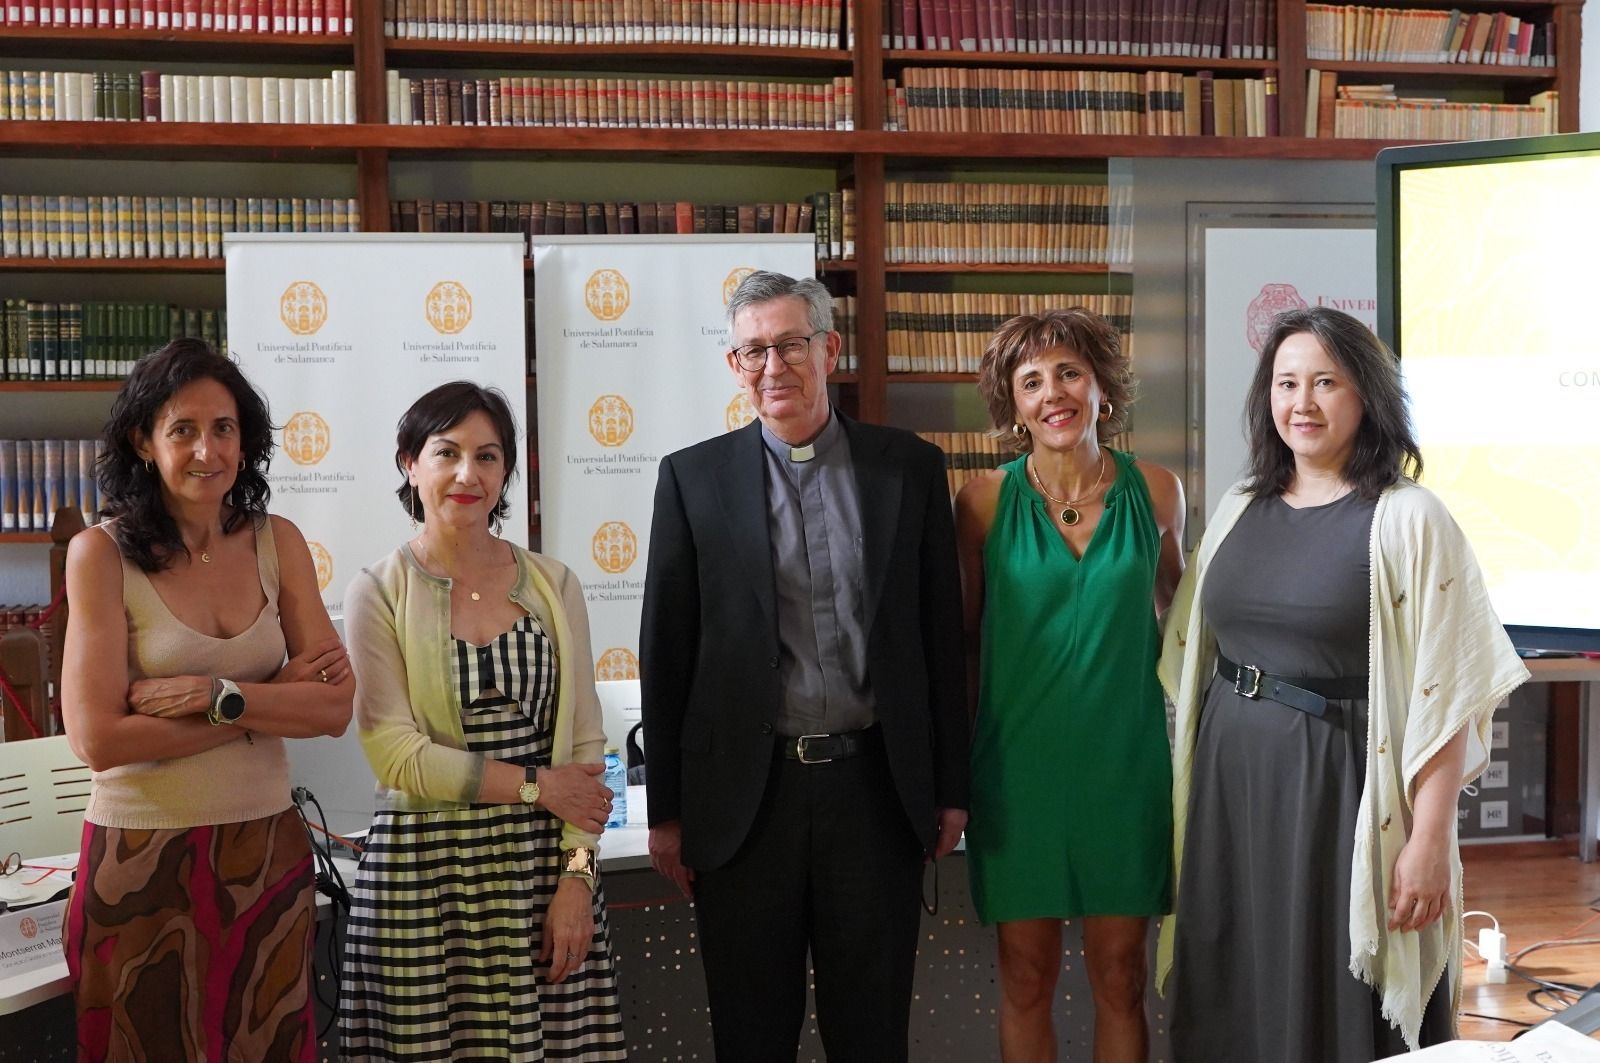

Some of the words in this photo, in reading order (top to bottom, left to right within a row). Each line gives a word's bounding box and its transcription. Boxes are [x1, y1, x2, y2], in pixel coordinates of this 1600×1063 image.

[563, 327, 613, 338] Universidad
[615, 327, 654, 337] Pontificia
[701, 326, 728, 336] Univer
[257, 342, 310, 352] Universidad
[311, 342, 352, 352] Pontificia
[402, 341, 454, 351] Universidad
[456, 341, 497, 351] Pontificia
[580, 339, 590, 349] de
[592, 338, 638, 348] Salamanca
[274, 354, 285, 363] de
[287, 354, 335, 363] Salamanca
[420, 353, 431, 362] de
[432, 353, 479, 362] Salamanca
[567, 454, 617, 464] Universidad
[619, 453, 657, 463] Pontificia
[583, 465, 594, 475] de
[595, 465, 641, 474] Salamanca
[314, 471, 355, 481] Pontificia
[277, 484, 288, 493] de
[289, 484, 338, 493] Salamanca
[587, 593, 598, 601] de
